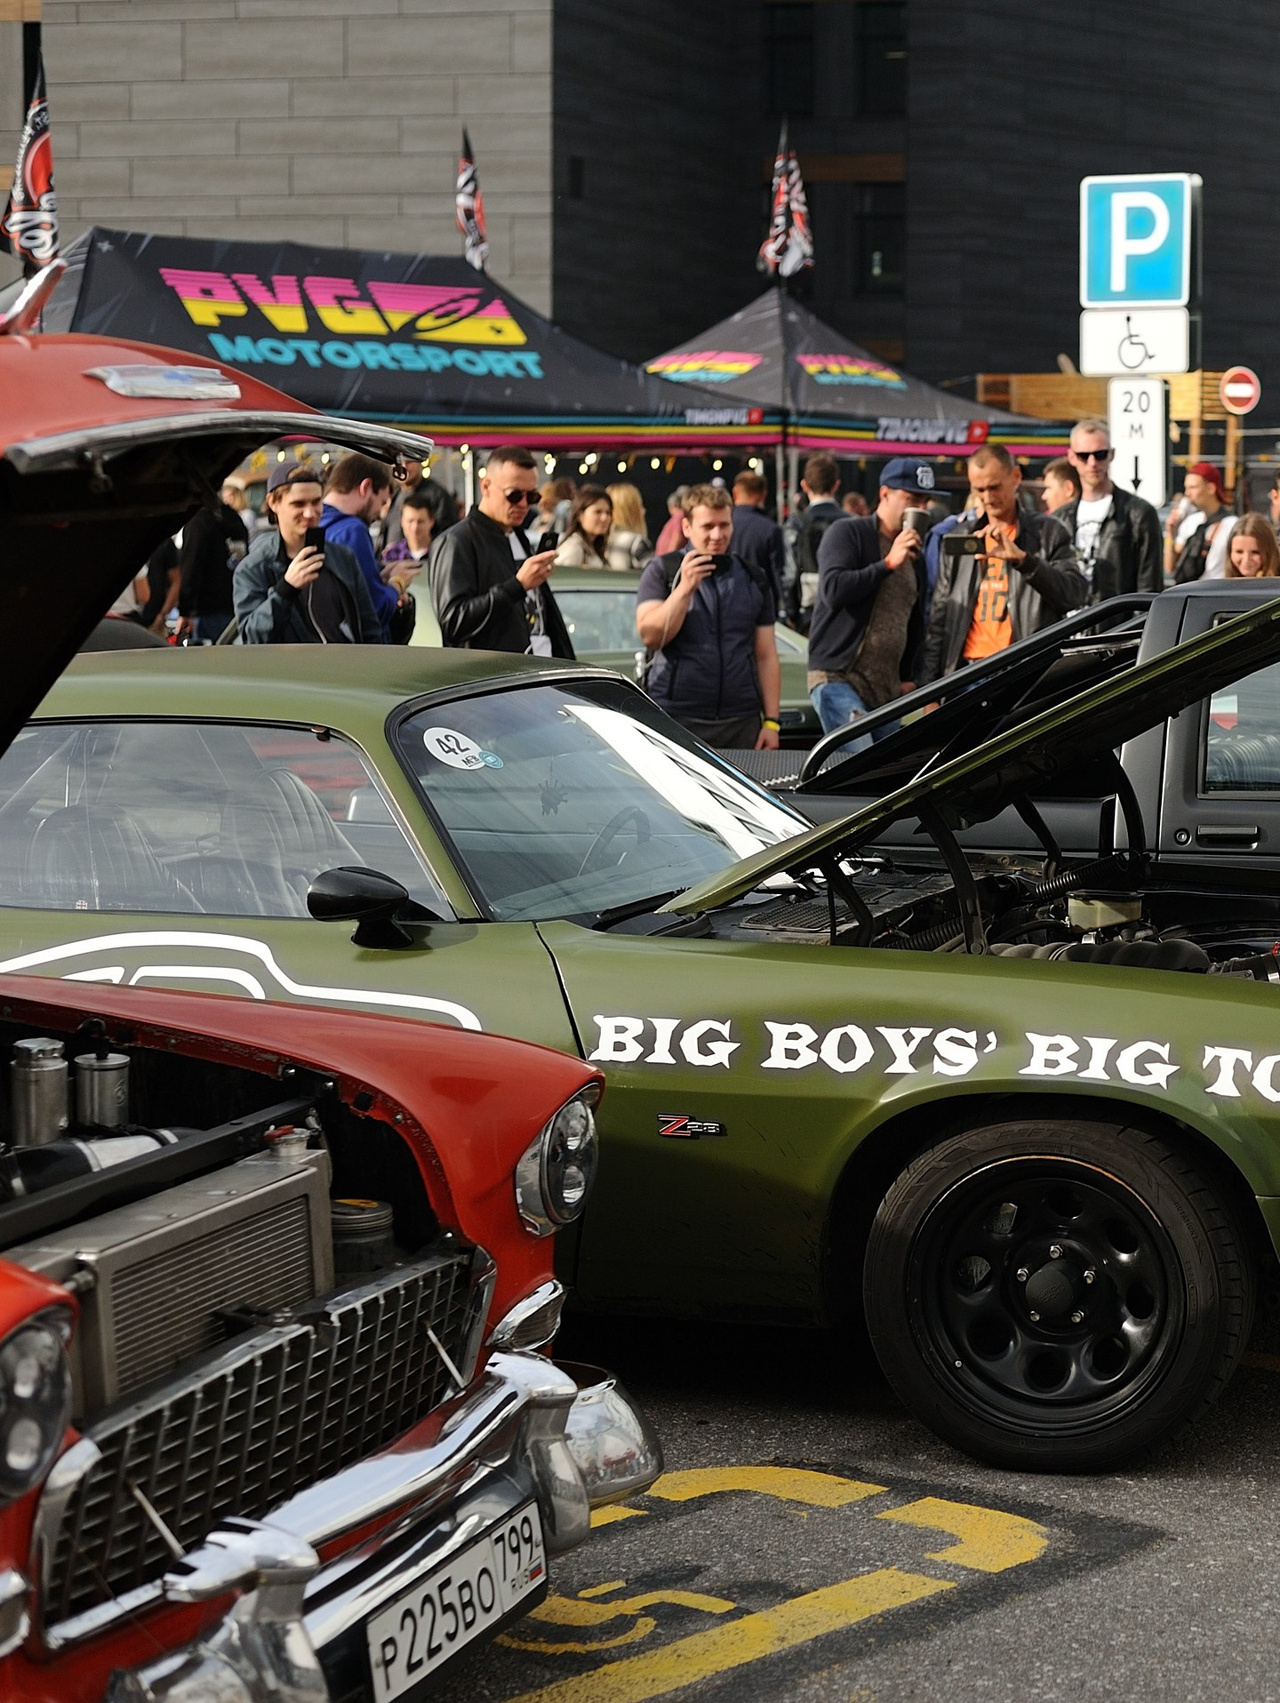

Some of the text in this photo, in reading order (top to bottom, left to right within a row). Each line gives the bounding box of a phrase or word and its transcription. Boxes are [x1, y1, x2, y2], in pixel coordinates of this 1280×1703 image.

[1109, 190, 1171, 293] P
[207, 332, 545, 379] MOTORSPORT
[1122, 390, 1151, 414] 20
[1128, 423, 1144, 439] M
[435, 734, 470, 755] 42
[589, 1014, 741, 1070] BIG
[760, 1020, 998, 1076] BOYS'
[1018, 1031, 1181, 1091] BIG
[494, 1515, 534, 1583] 799
